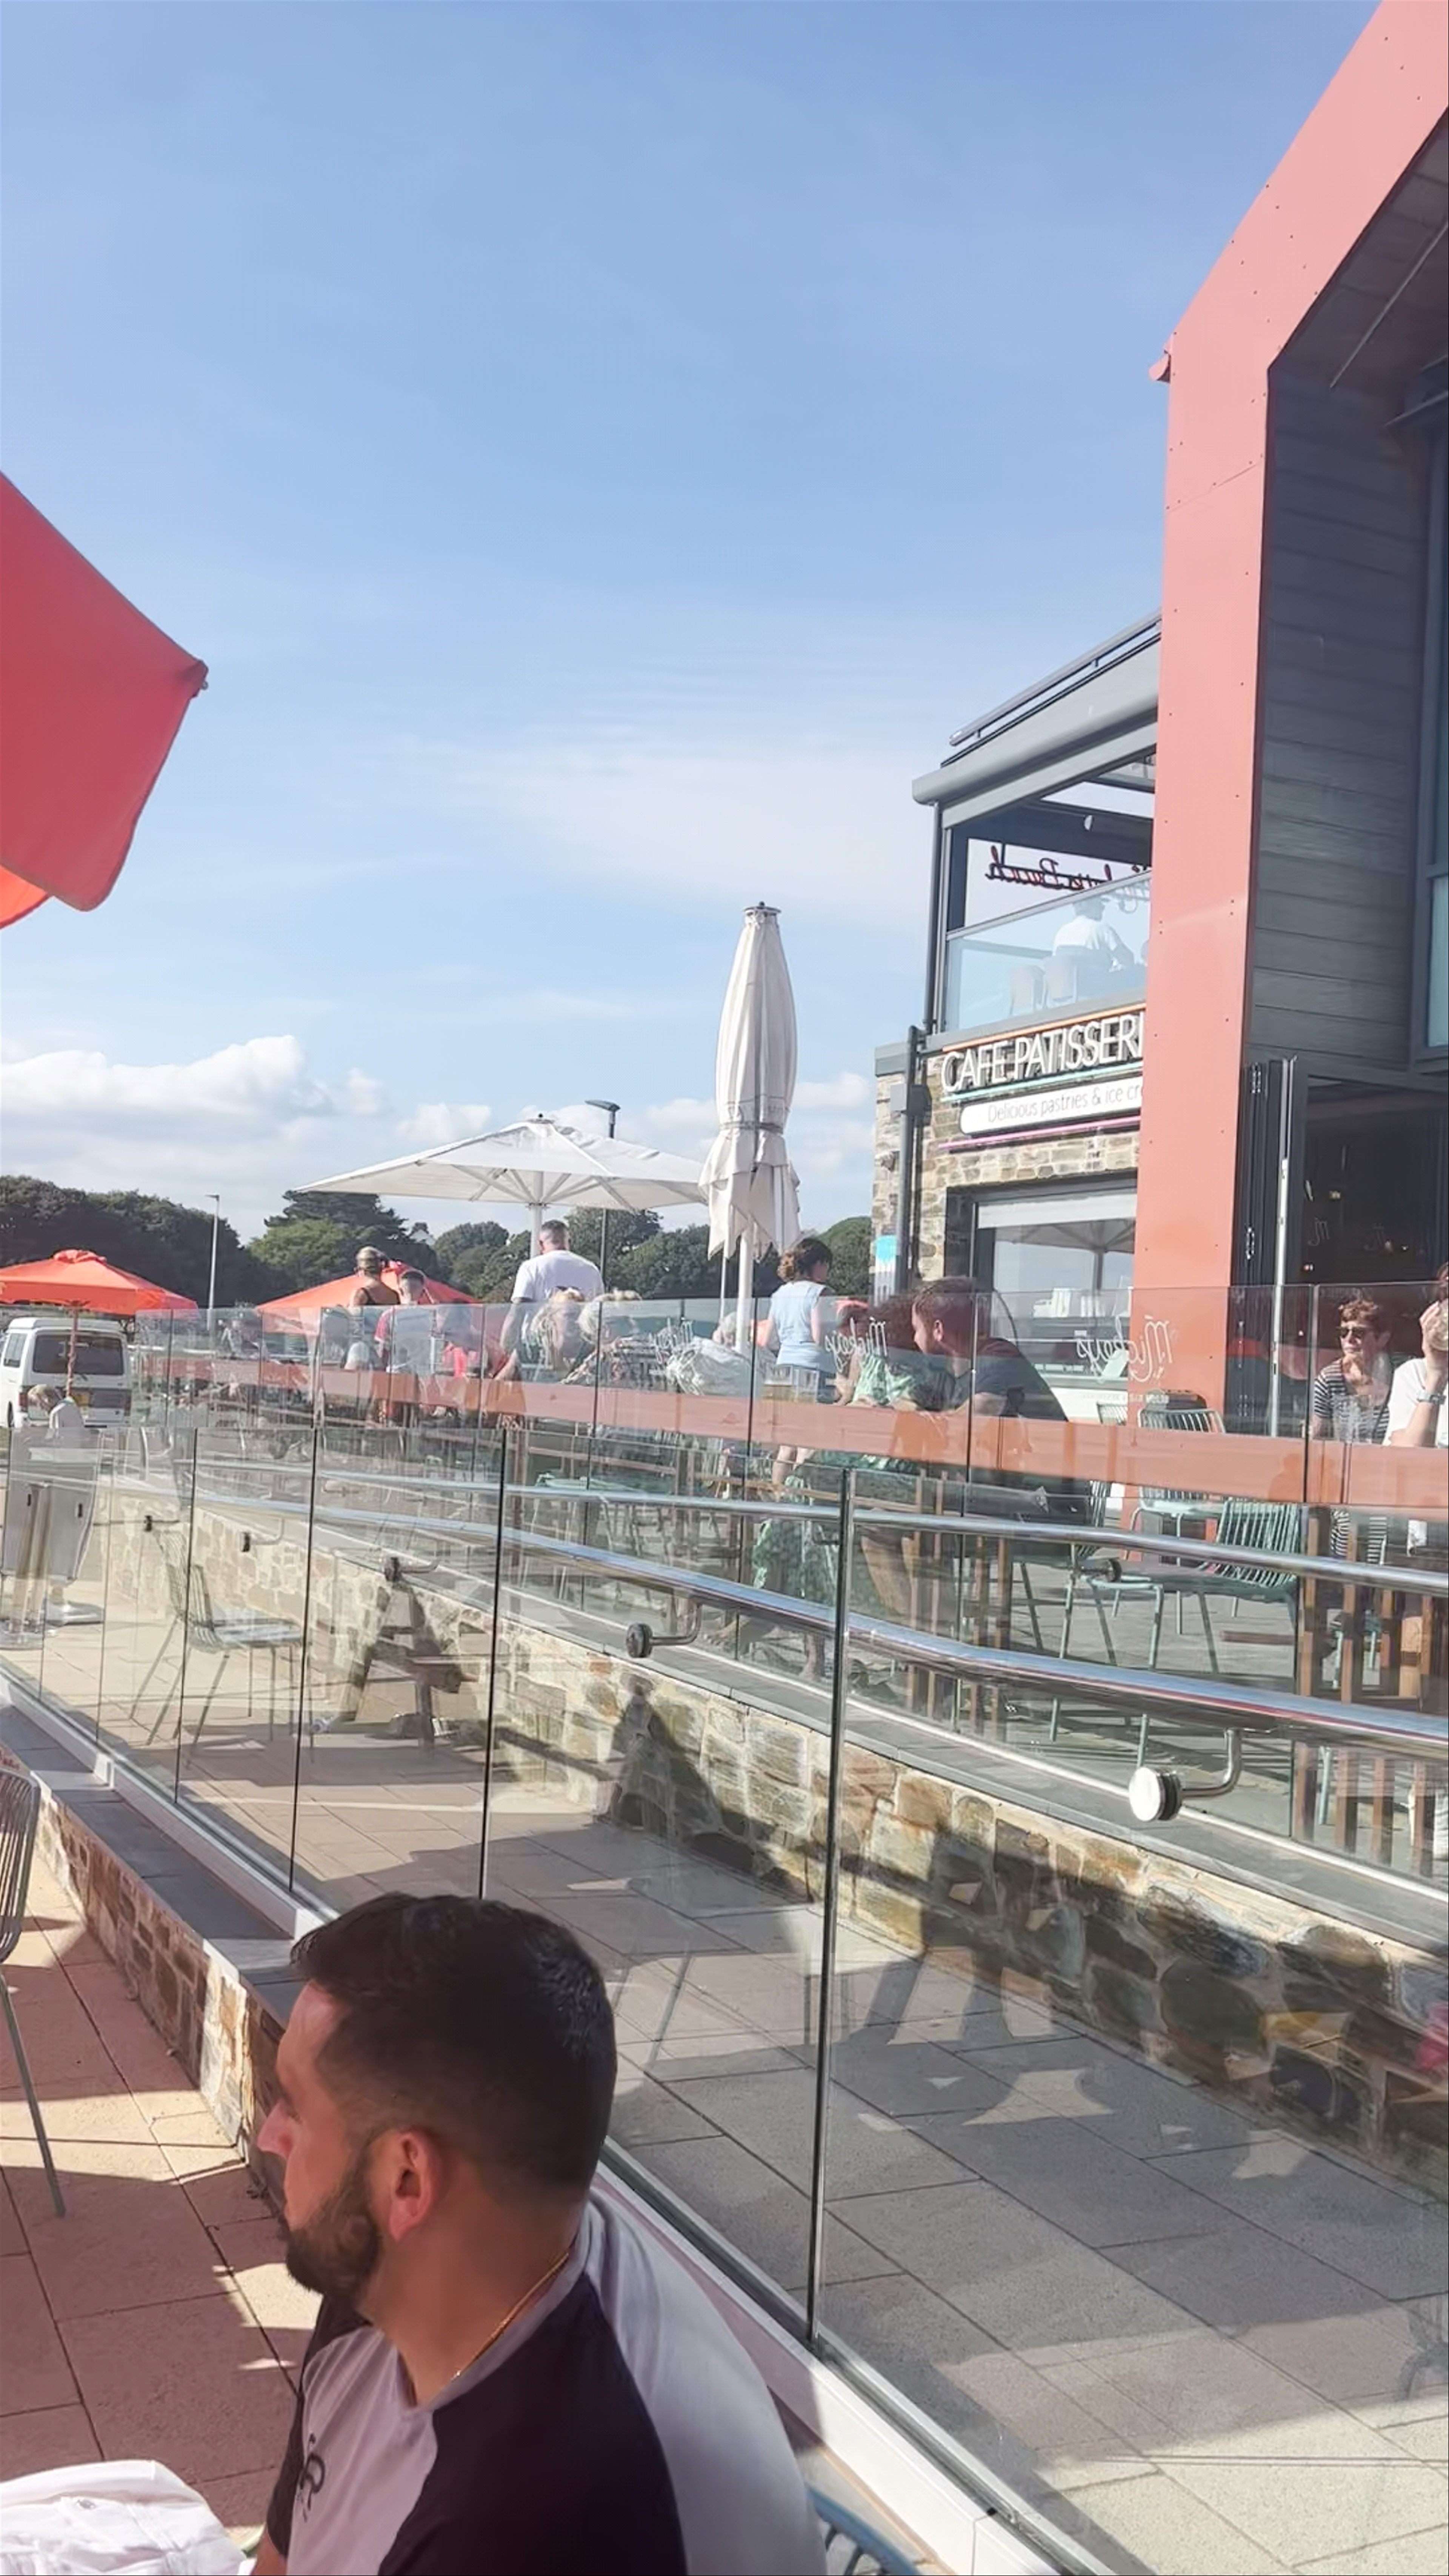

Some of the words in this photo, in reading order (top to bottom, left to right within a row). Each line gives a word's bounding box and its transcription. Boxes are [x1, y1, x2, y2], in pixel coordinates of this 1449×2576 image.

[941, 1040, 1009, 1092] CAFE
[988, 1102, 1037, 1123] Delicious
[1041, 1091, 1088, 1117] pastries
[1092, 1086, 1101, 1105] &
[1106, 1084, 1123, 1103] ice
[1127, 1084, 1143, 1101] cr
